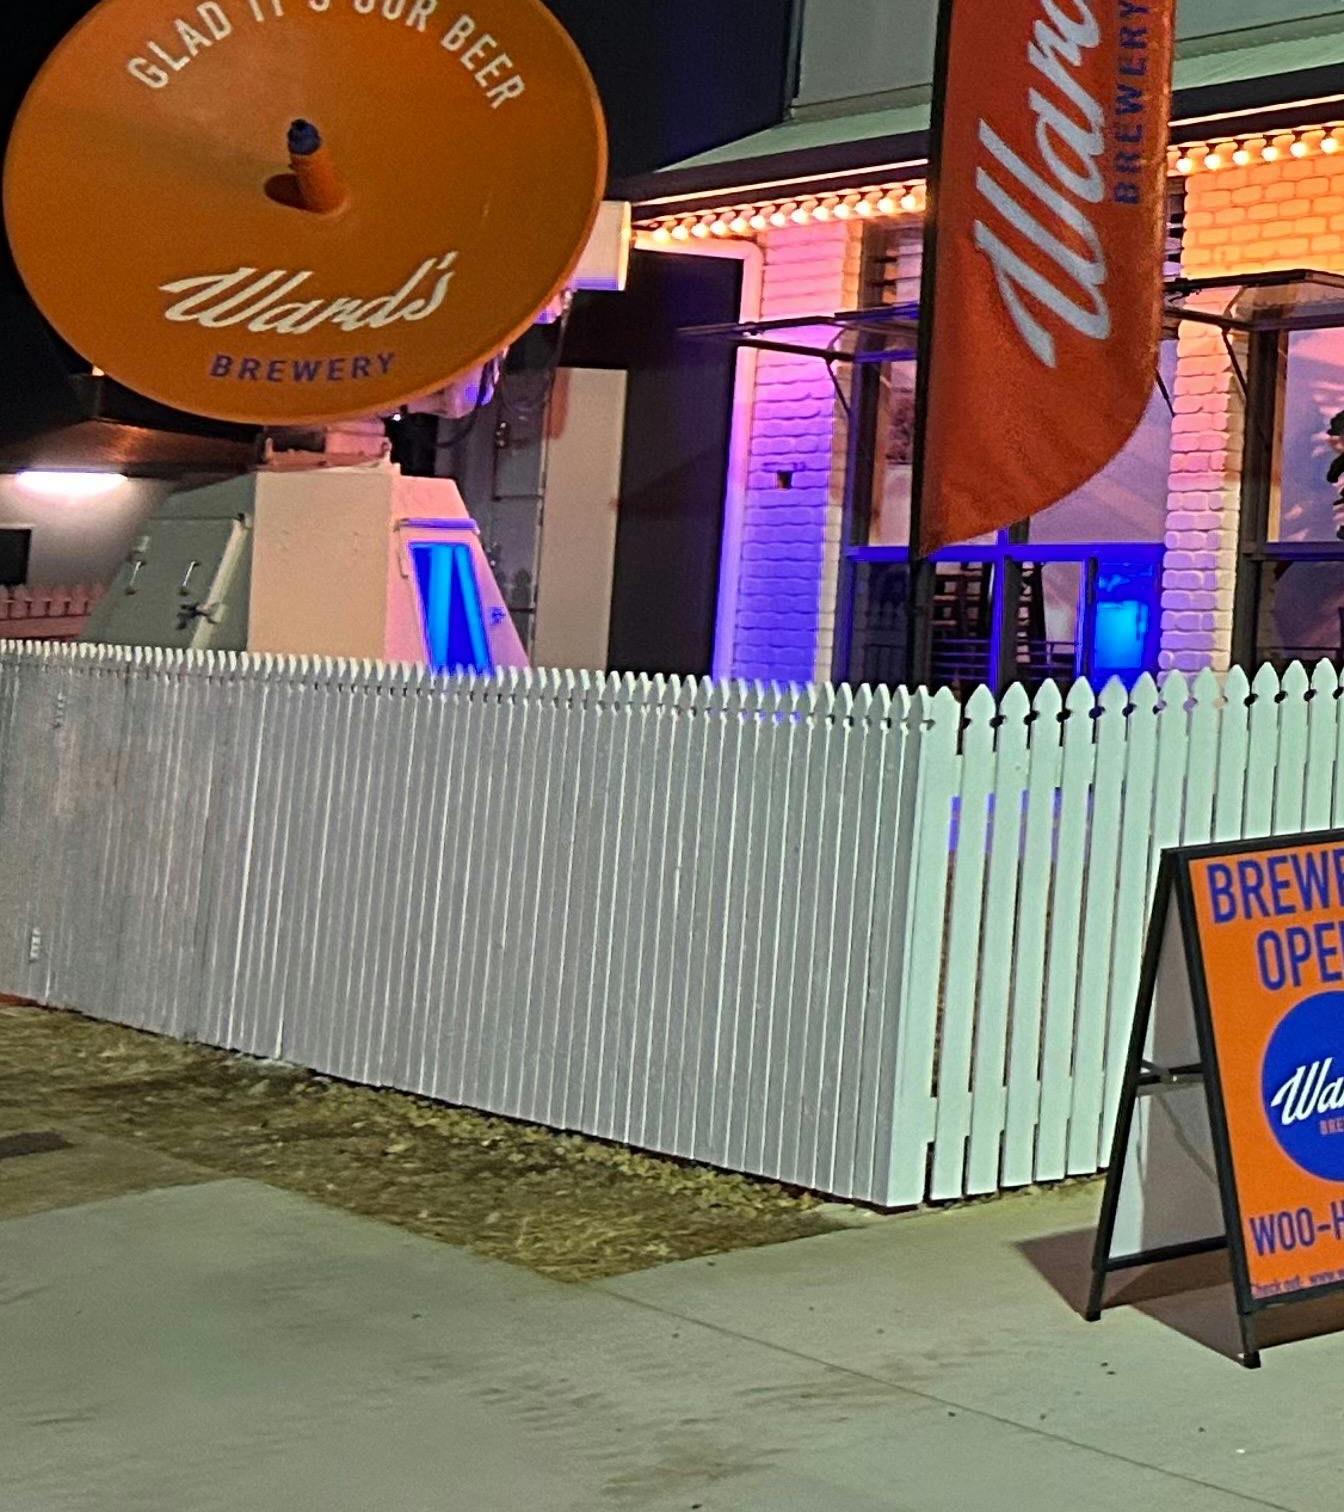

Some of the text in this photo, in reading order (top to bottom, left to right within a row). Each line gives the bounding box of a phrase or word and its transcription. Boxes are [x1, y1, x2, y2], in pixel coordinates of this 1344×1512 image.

[126, 0, 233, 90] GLAD
[440, 14, 525, 110] BEER
[158, 250, 458, 335] Ward's
[209, 352, 396, 383] BREWERY
